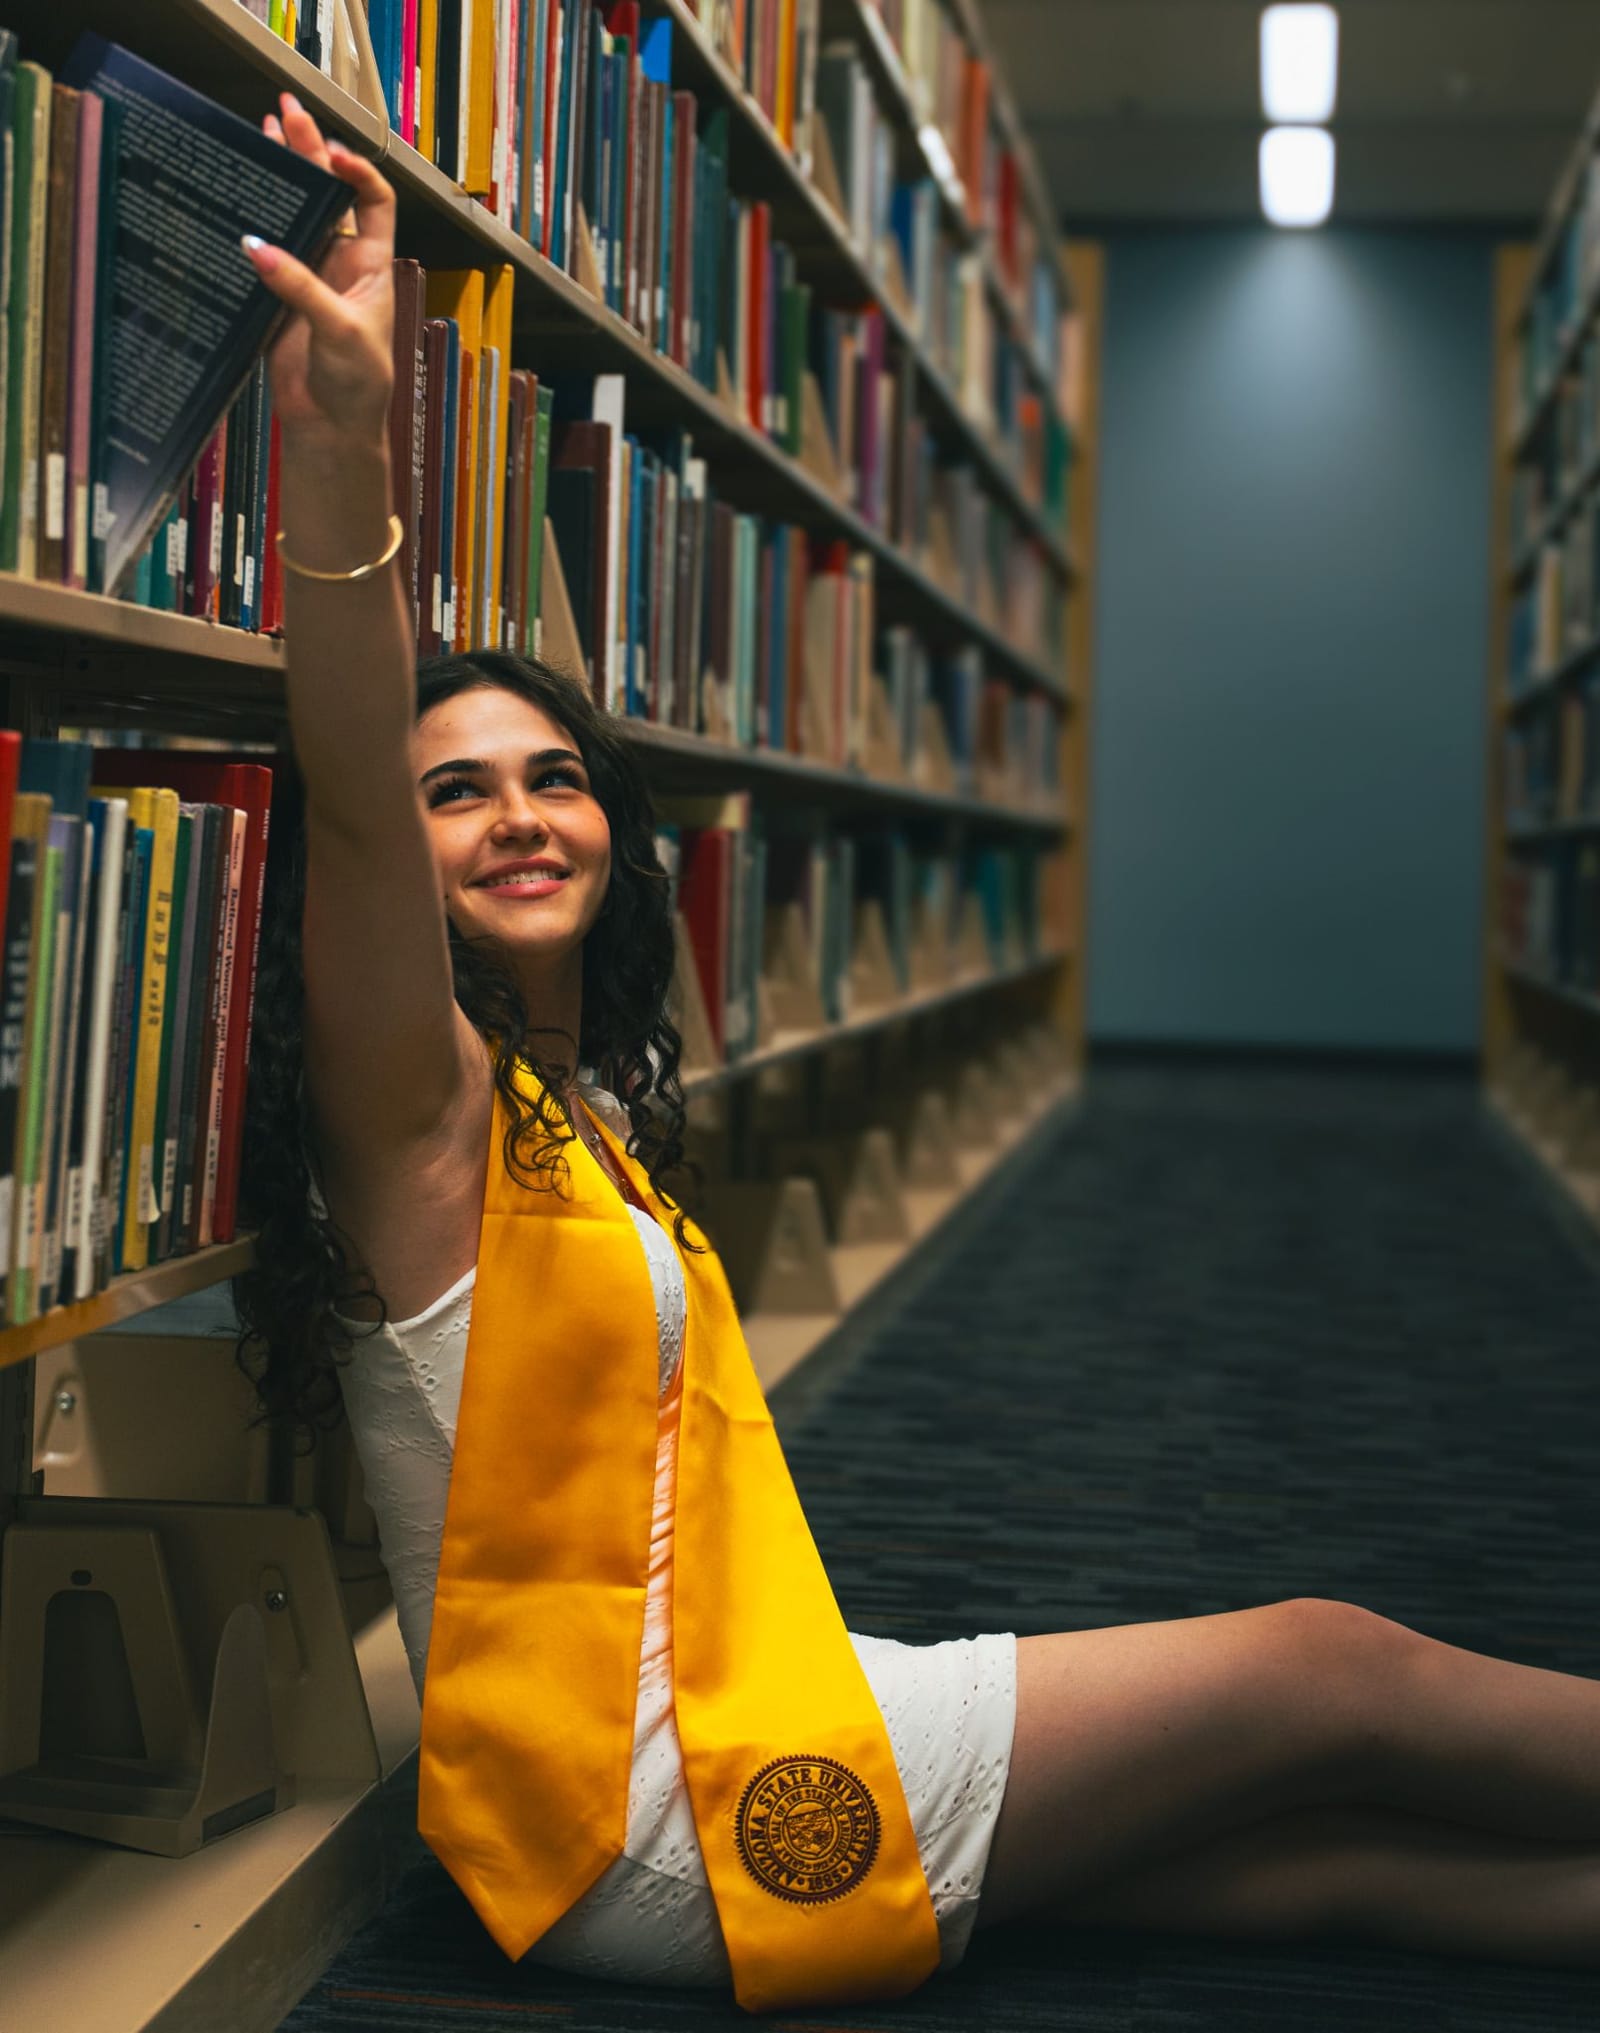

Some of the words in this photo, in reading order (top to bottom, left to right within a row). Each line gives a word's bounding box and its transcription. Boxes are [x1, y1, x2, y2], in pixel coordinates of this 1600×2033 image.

[226, 889, 238, 949] Battered
[223, 954, 232, 1008] Women
[757, 1768, 812, 1808] STATE
[774, 1805, 787, 1817] OF
[785, 1791, 803, 1806] THE
[806, 1790, 835, 1806] STATE
[819, 1771, 868, 1869] UNIVERSITY
[750, 1816, 798, 1886] ARIZONA
[808, 1871, 841, 1890] 1885
